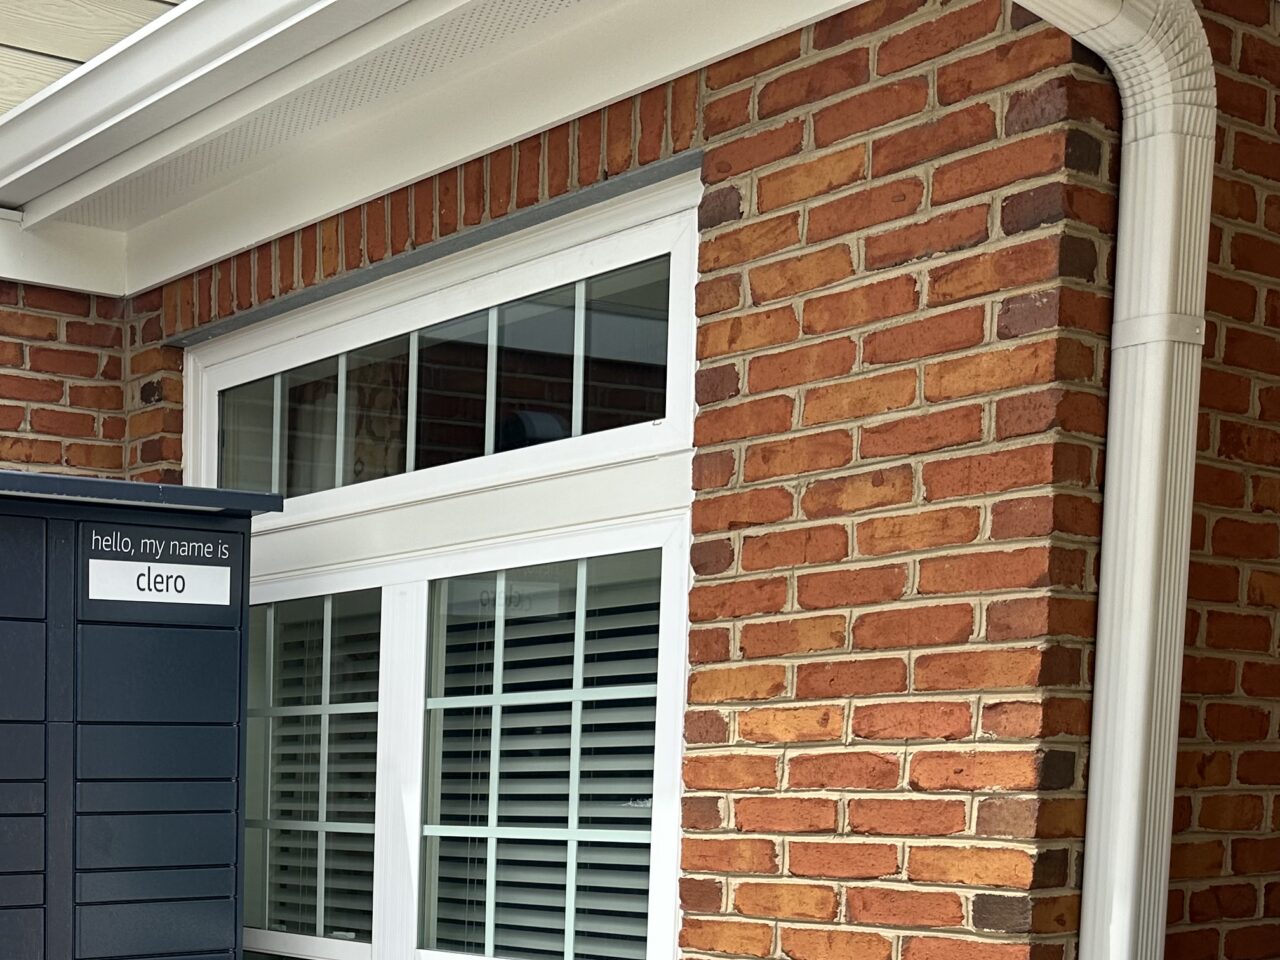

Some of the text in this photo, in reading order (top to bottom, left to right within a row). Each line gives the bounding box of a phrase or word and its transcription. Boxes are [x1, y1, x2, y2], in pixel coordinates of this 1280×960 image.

[91, 530, 230, 560] hello, my name is
[136, 565, 186, 594] clero
